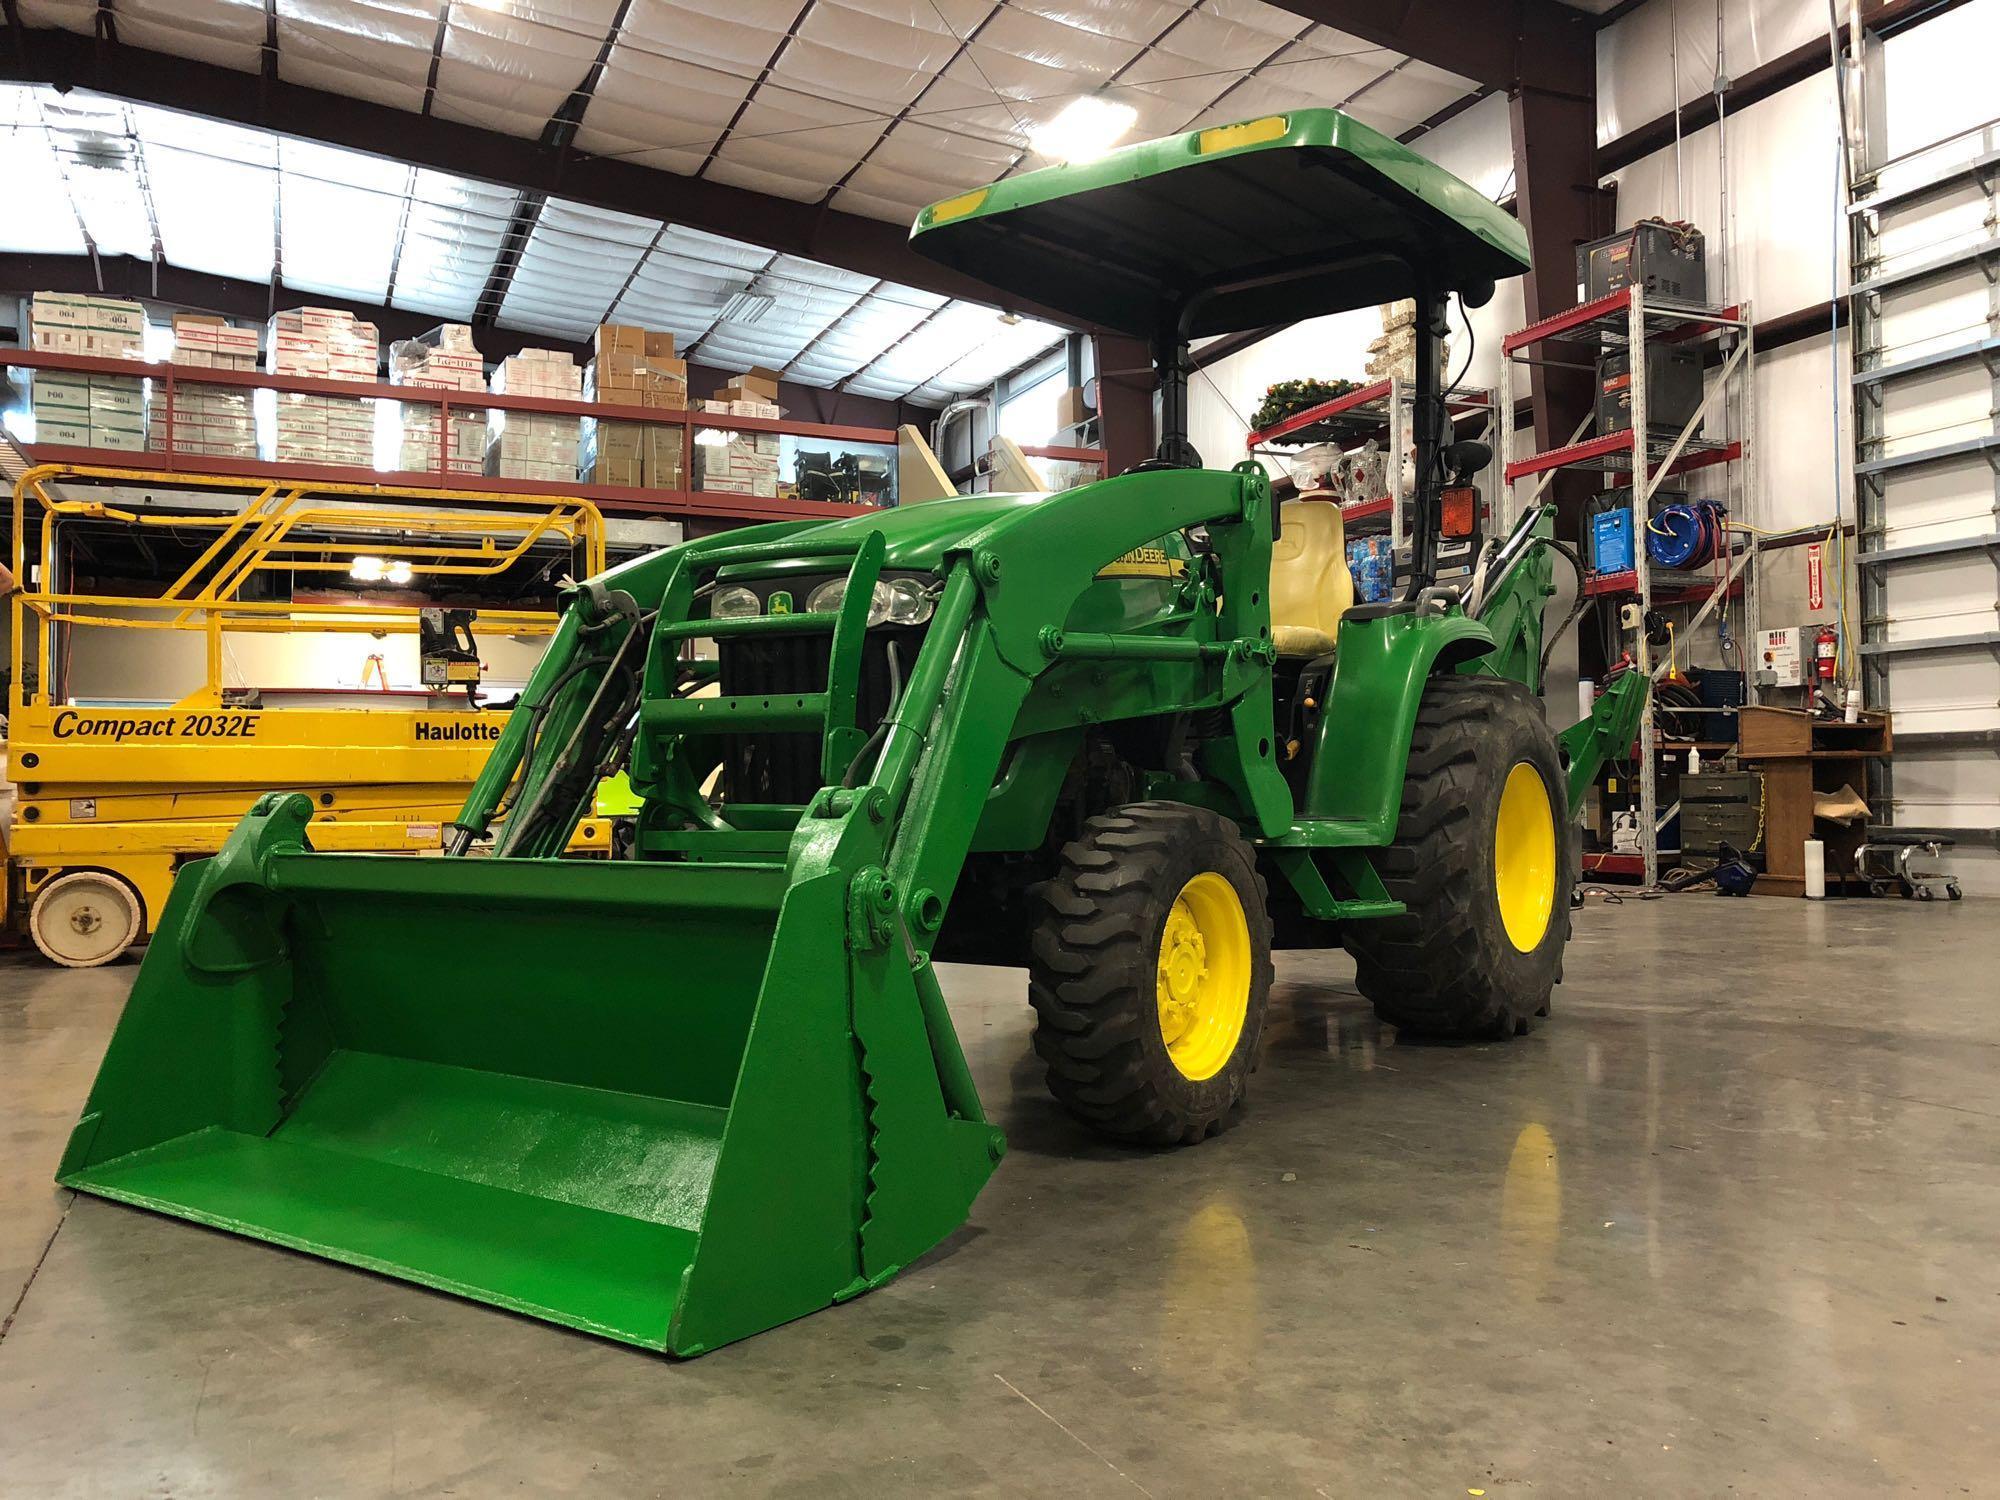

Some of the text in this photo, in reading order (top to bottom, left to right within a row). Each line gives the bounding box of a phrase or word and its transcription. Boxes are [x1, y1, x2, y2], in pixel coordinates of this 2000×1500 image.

[58, 309, 75, 319] 004
[1603, 377, 1618, 388] MAC
[114, 396, 130, 404] 004
[59, 431, 76, 439] 004
[1135, 547, 1167, 565] DEERE
[1768, 631, 1786, 639] RITE
[52, 710, 261, 742] Compact 2032E
[415, 721, 500, 741] Haulotte
